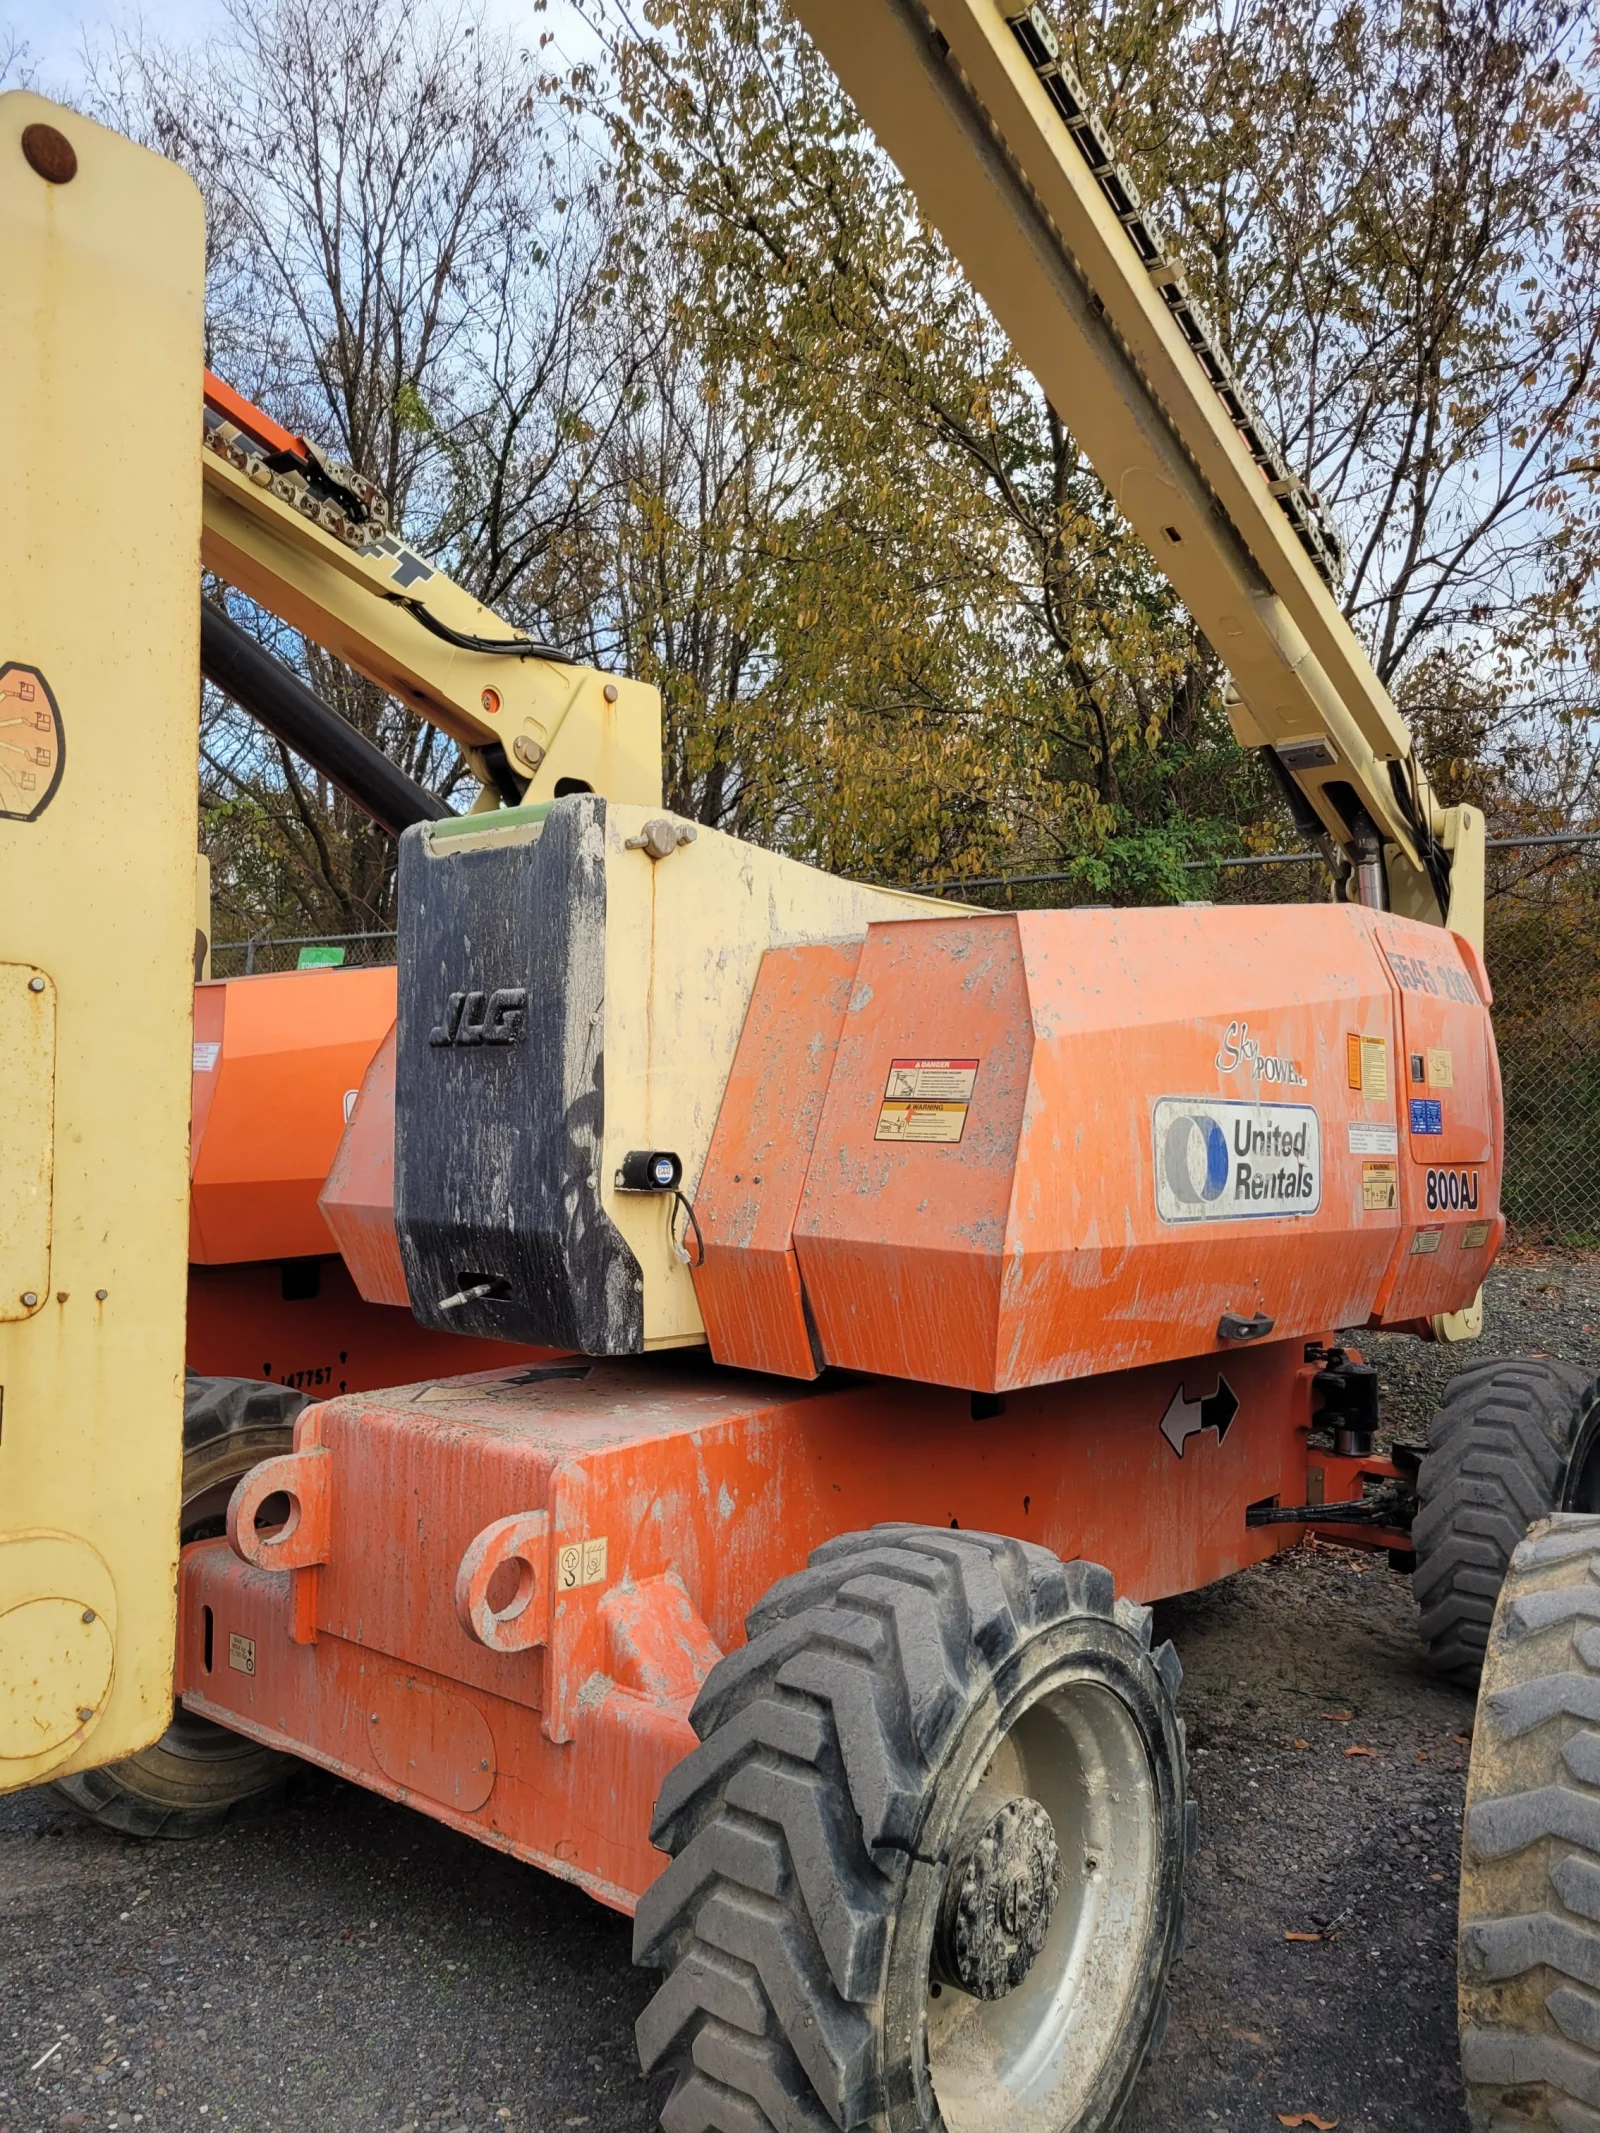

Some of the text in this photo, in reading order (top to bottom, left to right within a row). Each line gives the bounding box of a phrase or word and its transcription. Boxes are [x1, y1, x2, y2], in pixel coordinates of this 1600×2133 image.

[428, 988, 528, 1047] JLG
[1215, 1020, 1260, 1081] Sky
[912, 1103, 944, 1111] WARNING
[1234, 1119, 1307, 1158] United
[657, 1166, 671, 1176] ECCO
[1234, 1162, 1313, 1201] Rentals
[1426, 1168, 1479, 1211] 800AJ
